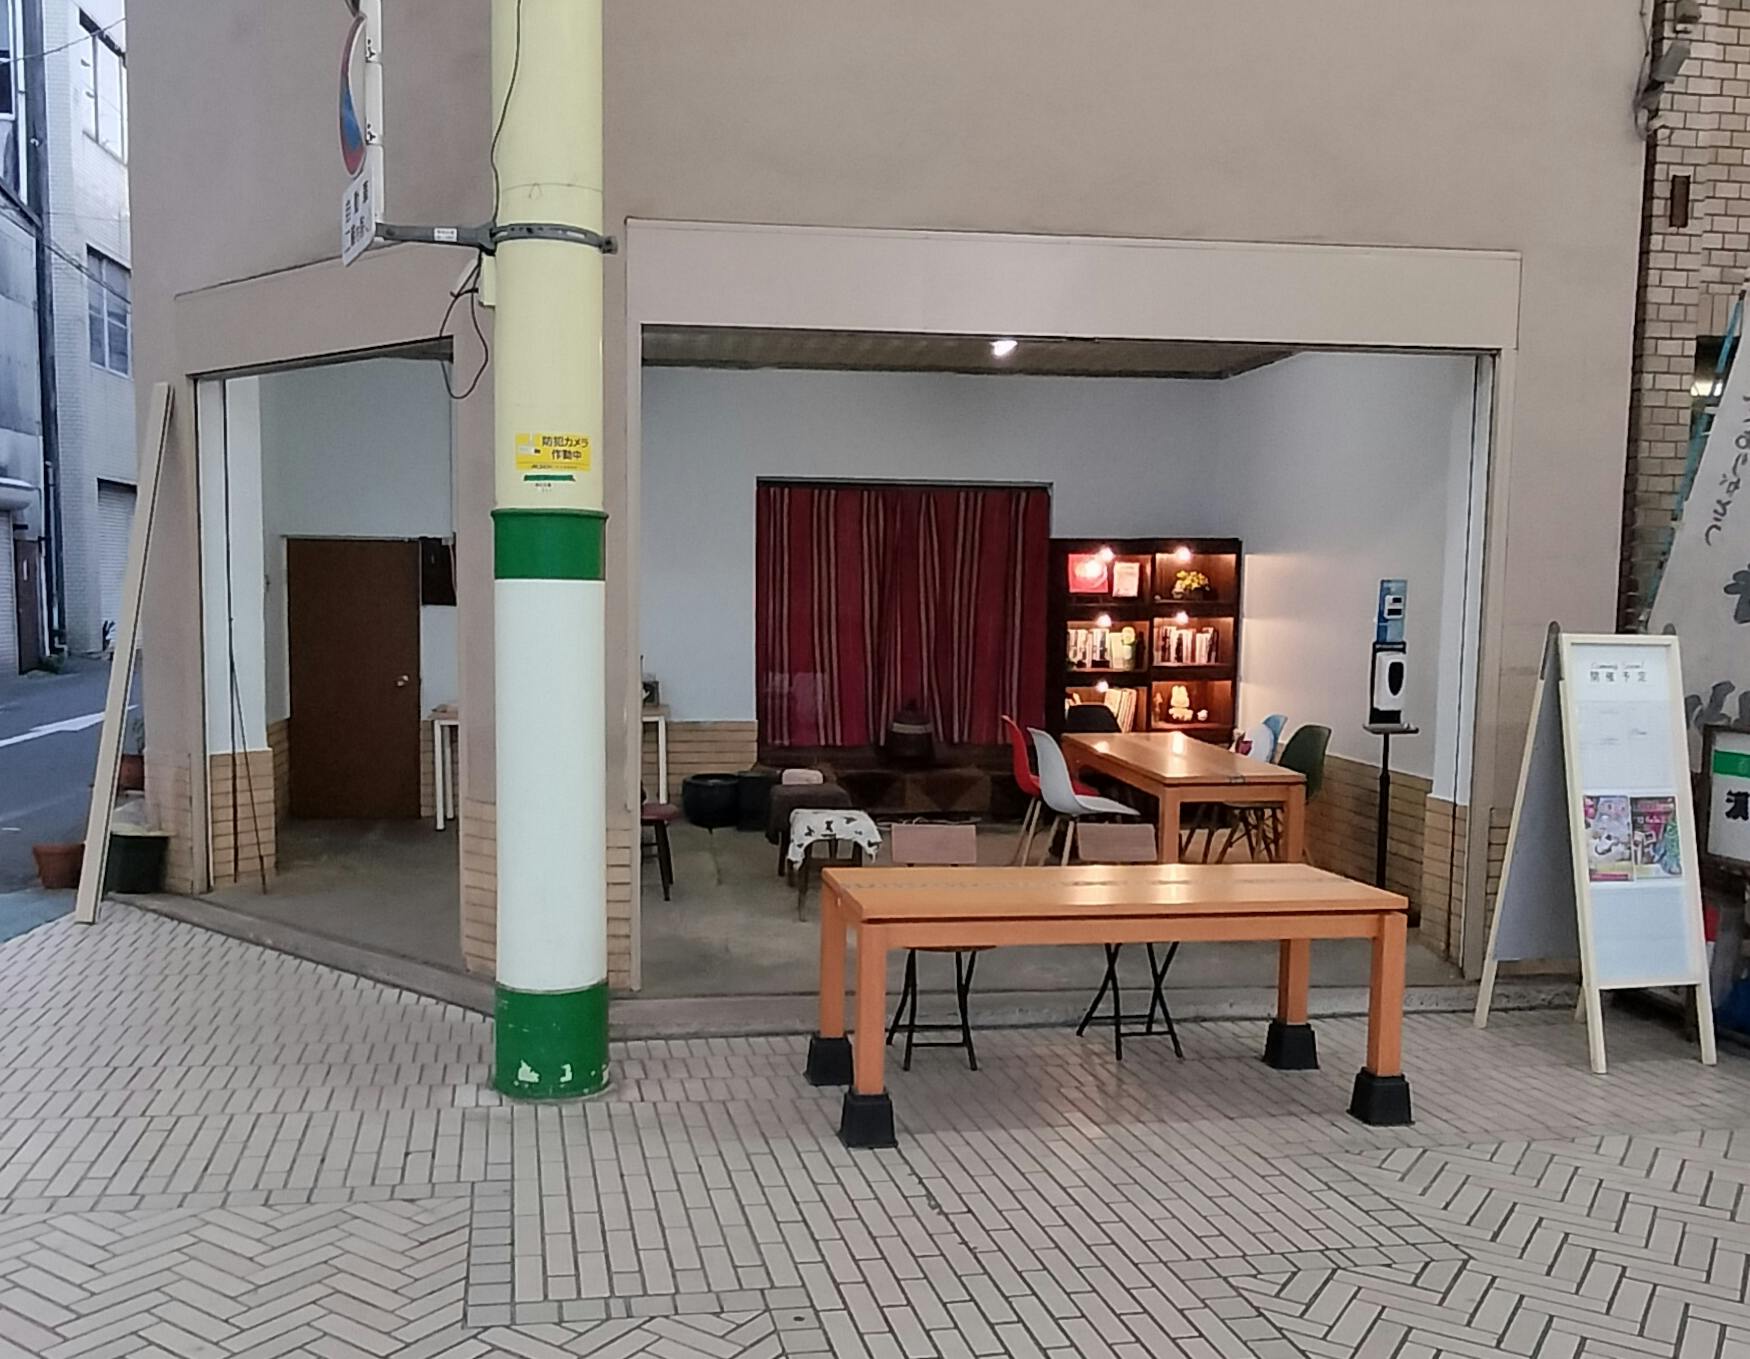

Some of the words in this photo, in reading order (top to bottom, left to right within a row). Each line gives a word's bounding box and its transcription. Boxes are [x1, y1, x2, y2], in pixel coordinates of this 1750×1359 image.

[541, 435, 589, 449] 防犯カメラ
[551, 448, 582, 460] 作動中
